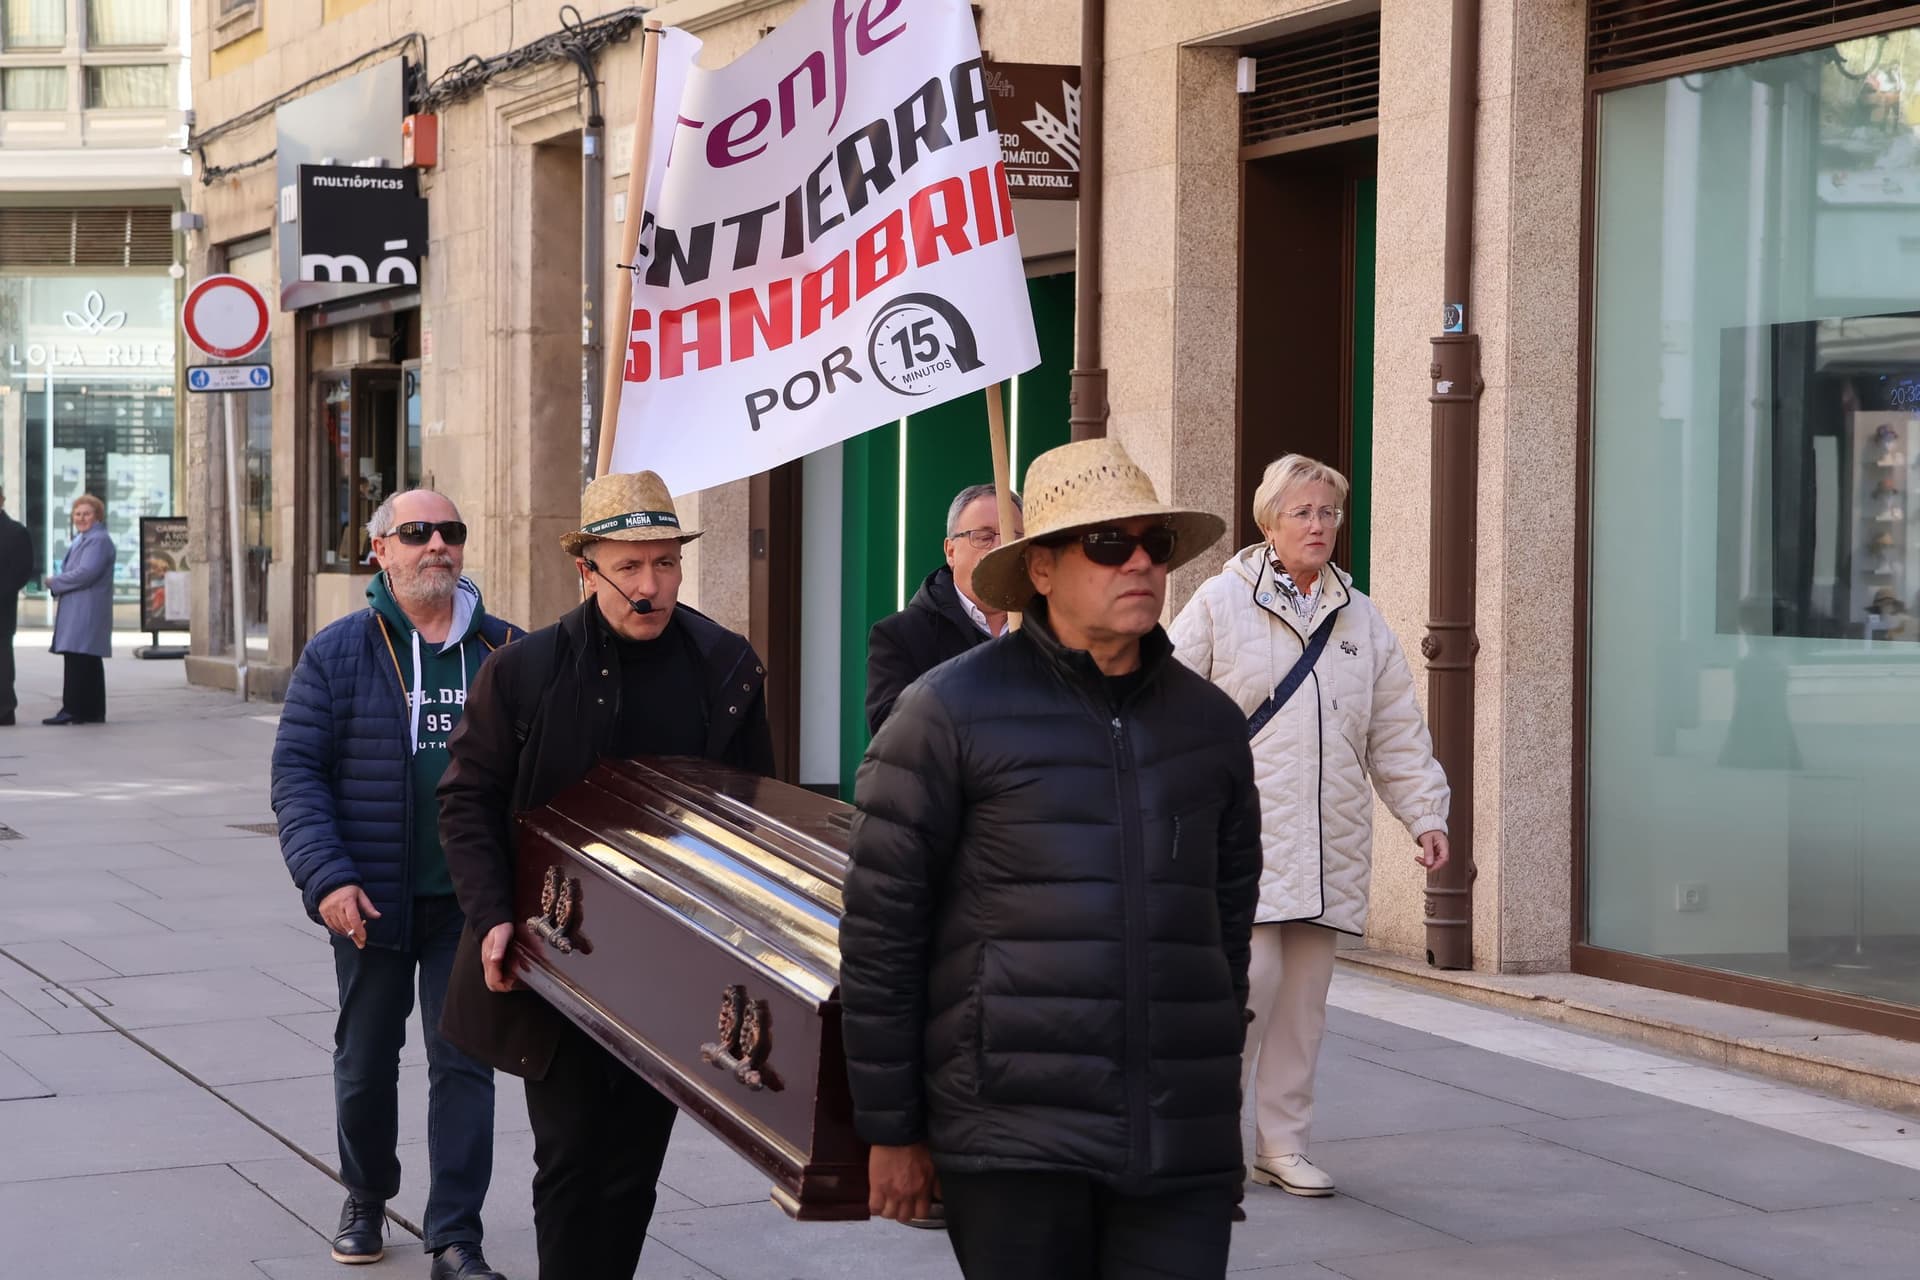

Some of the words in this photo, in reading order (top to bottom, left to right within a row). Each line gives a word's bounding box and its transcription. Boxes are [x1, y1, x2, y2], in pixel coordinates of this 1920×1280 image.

[999, 133, 1019, 147] ERO
[1001, 149, 1049, 164] OMÁTICO
[1028, 175, 1072, 187] RURAL
[9, 343, 87, 367] LOLA
[744, 346, 862, 432] POR
[891, 317, 940, 369] 15
[902, 359, 952, 384] MINUTOS
[626, 516, 651, 527] MAGNA
[427, 714, 452, 732] 95
[418, 741, 447, 749] UTH
